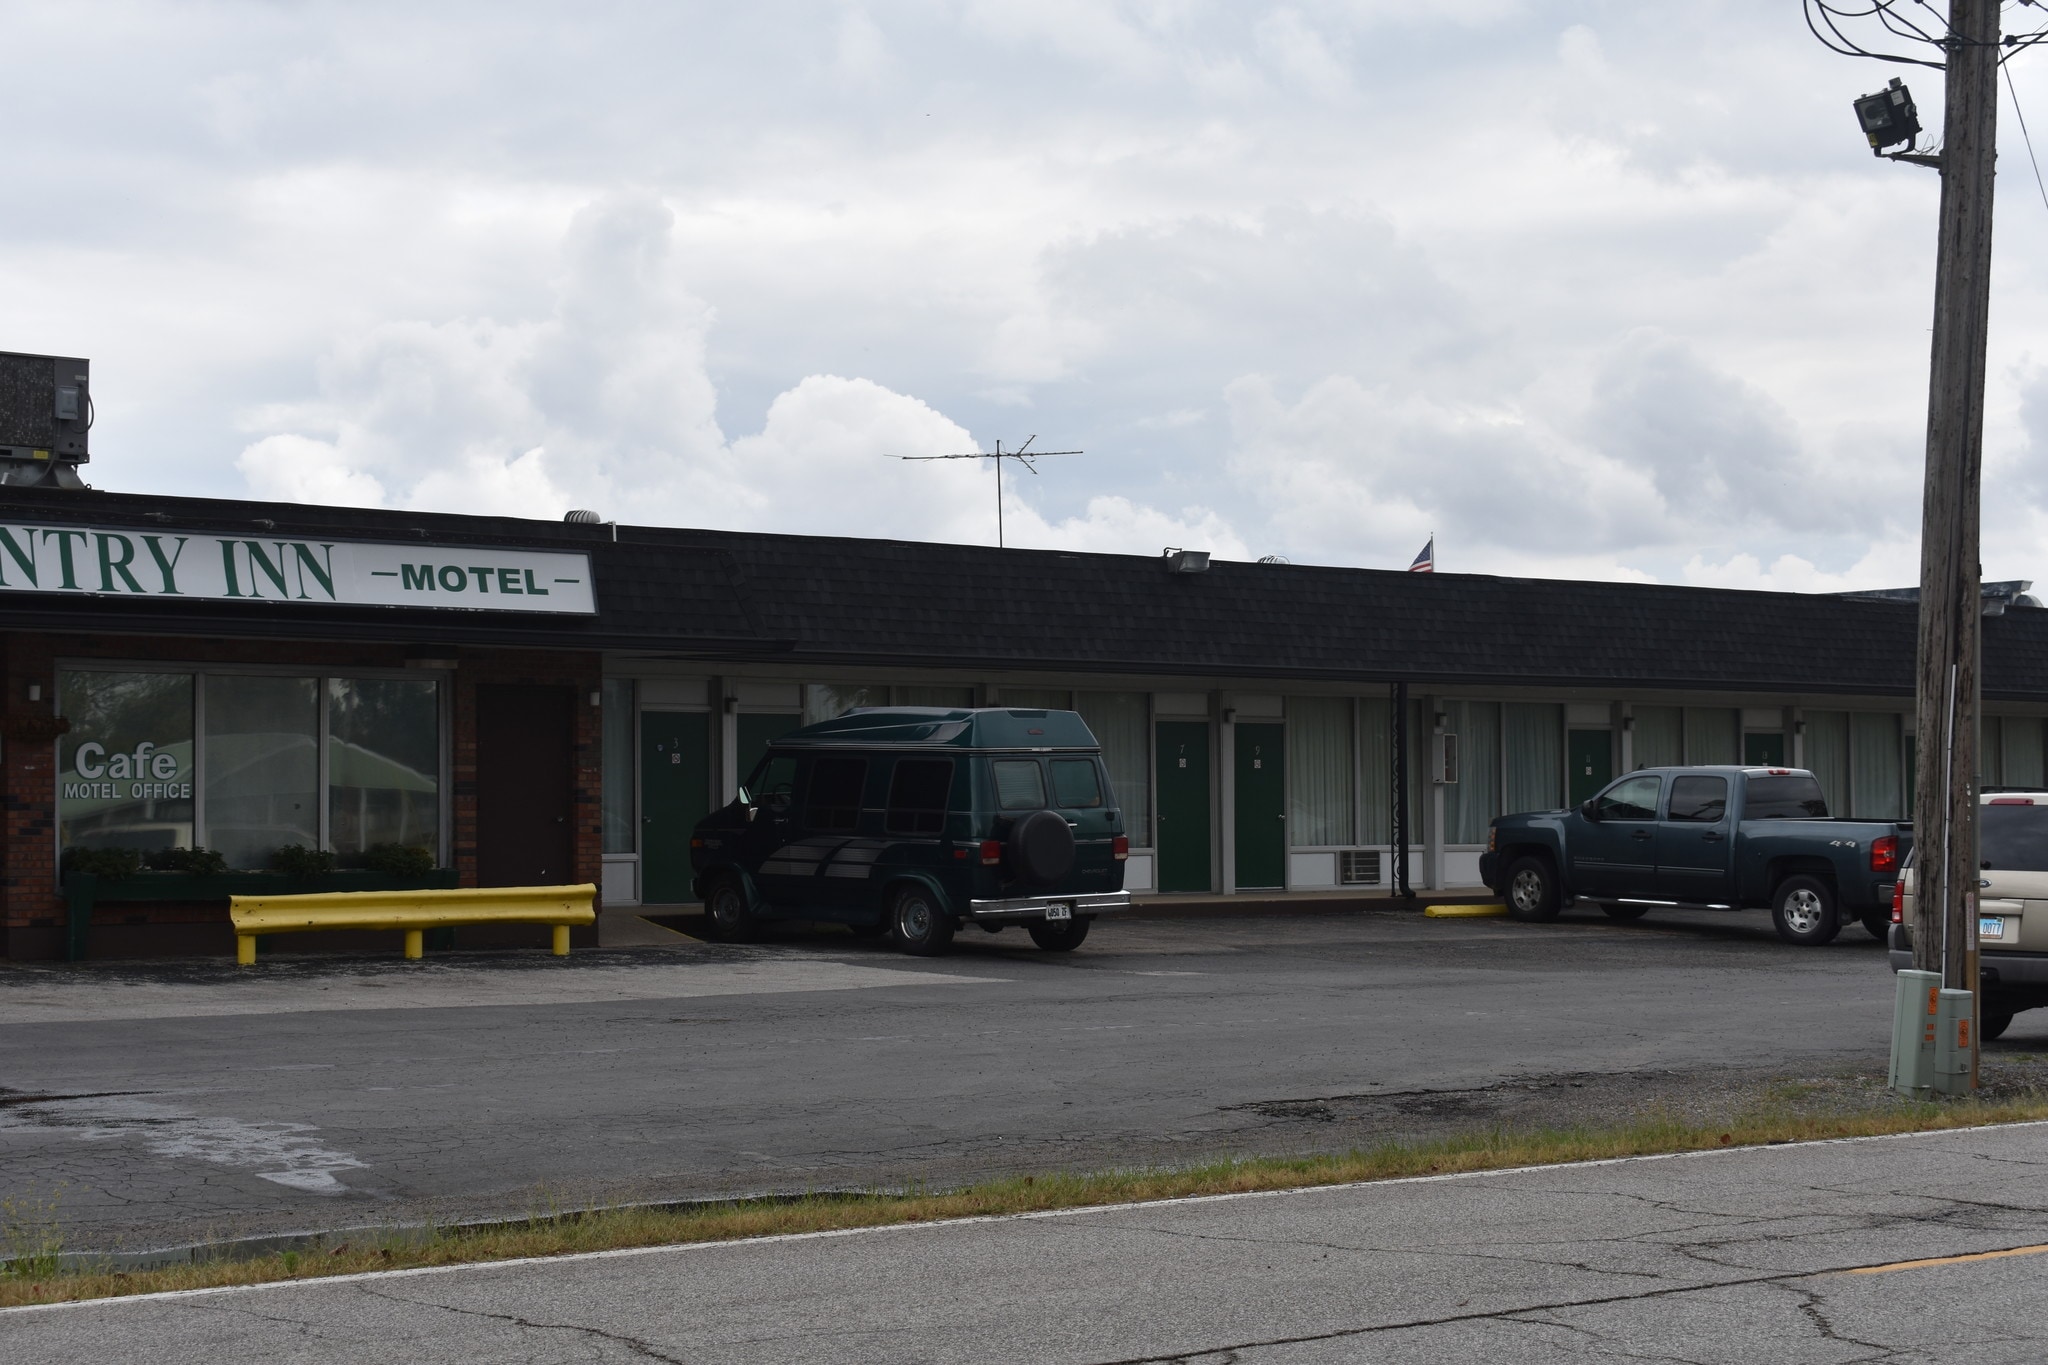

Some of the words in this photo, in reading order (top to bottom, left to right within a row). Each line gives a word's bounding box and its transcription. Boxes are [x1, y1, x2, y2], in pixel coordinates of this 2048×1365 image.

[216, 539, 336, 602] INN
[75, 741, 177, 780] Cafe
[64, 783, 122, 799] MOTEL
[131, 783, 191, 799] OFFICE
